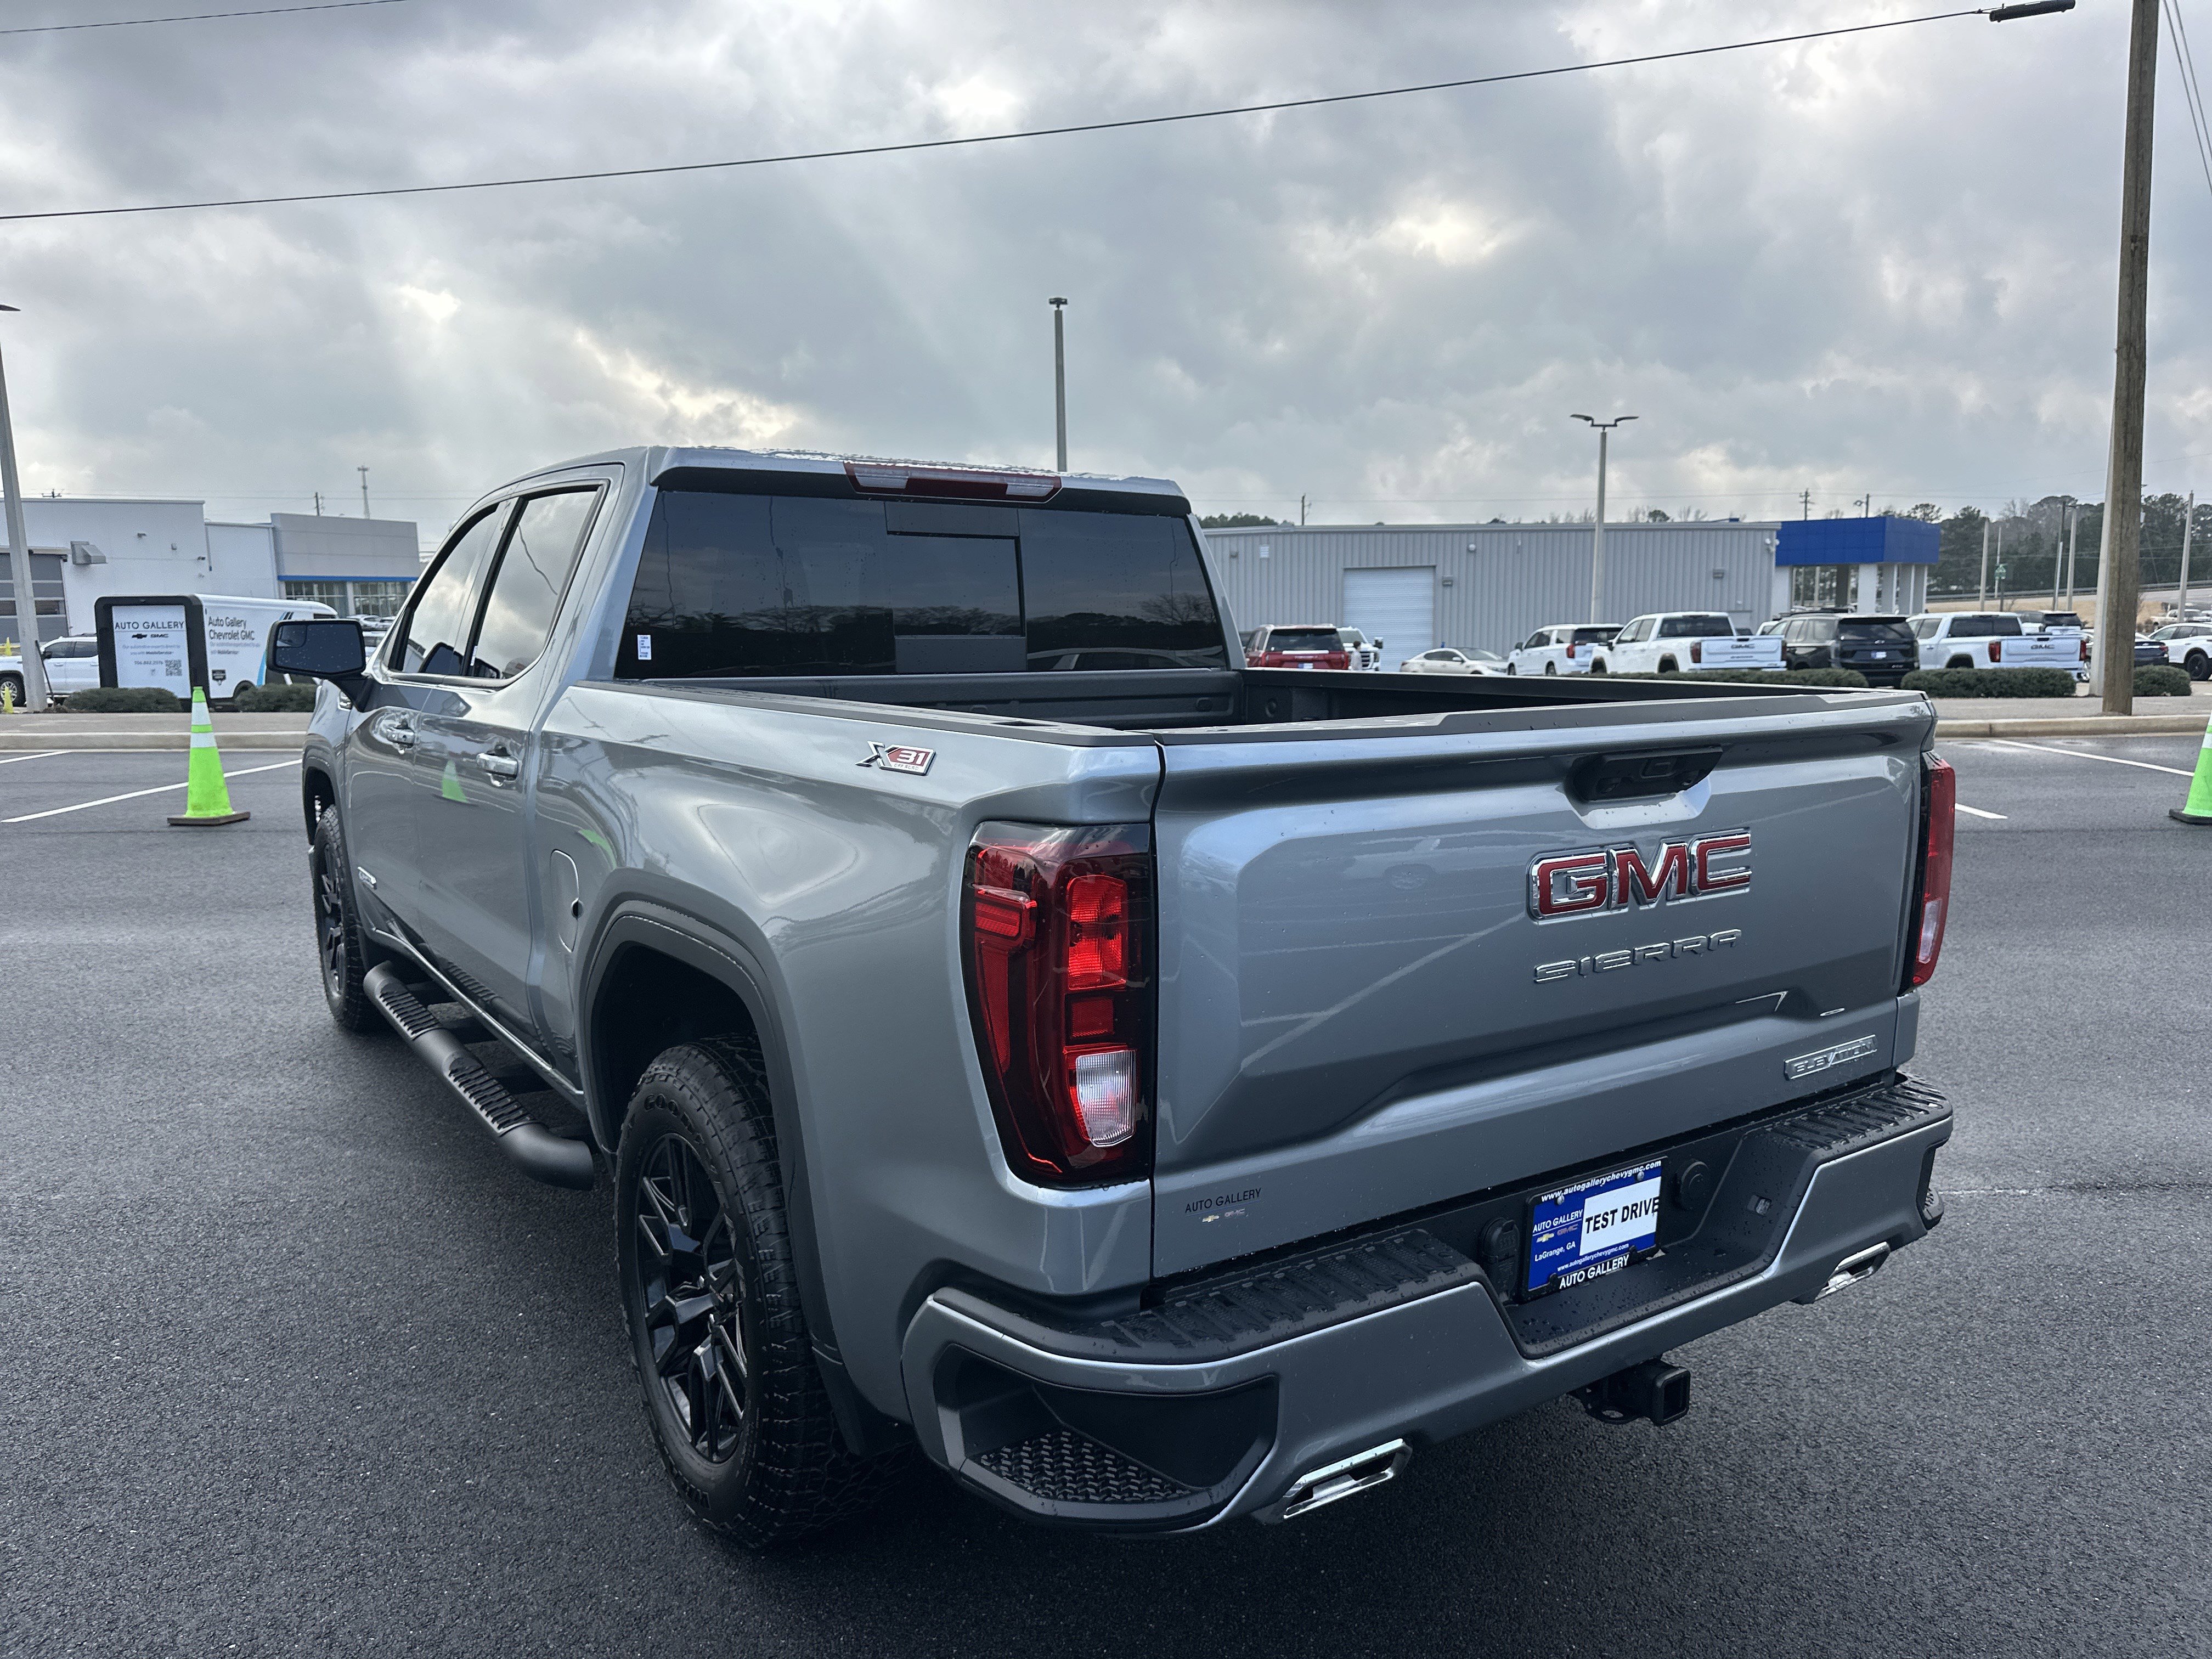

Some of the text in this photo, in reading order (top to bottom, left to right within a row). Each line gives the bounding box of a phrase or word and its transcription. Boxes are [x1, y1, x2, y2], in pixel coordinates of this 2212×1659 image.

[143, 621, 184, 629] GALLERY
[208, 616, 246, 629] Auto Gallery
[209, 629, 255, 640] Chevrolet GMC
[1527, 830, 1753, 924] GMC
[1534, 928, 1742, 984] SIERRA
[1185, 1187, 1262, 1214] AUTO GALLERY
[1532, 1209, 1583, 1233] AUTO GALLERY
[1585, 1196, 1660, 1234] TEST DRIVE
[1534, 1240, 1576, 1262] LaGrange, GA
[1559, 1254, 1629, 1289] AUTO GALLERY
